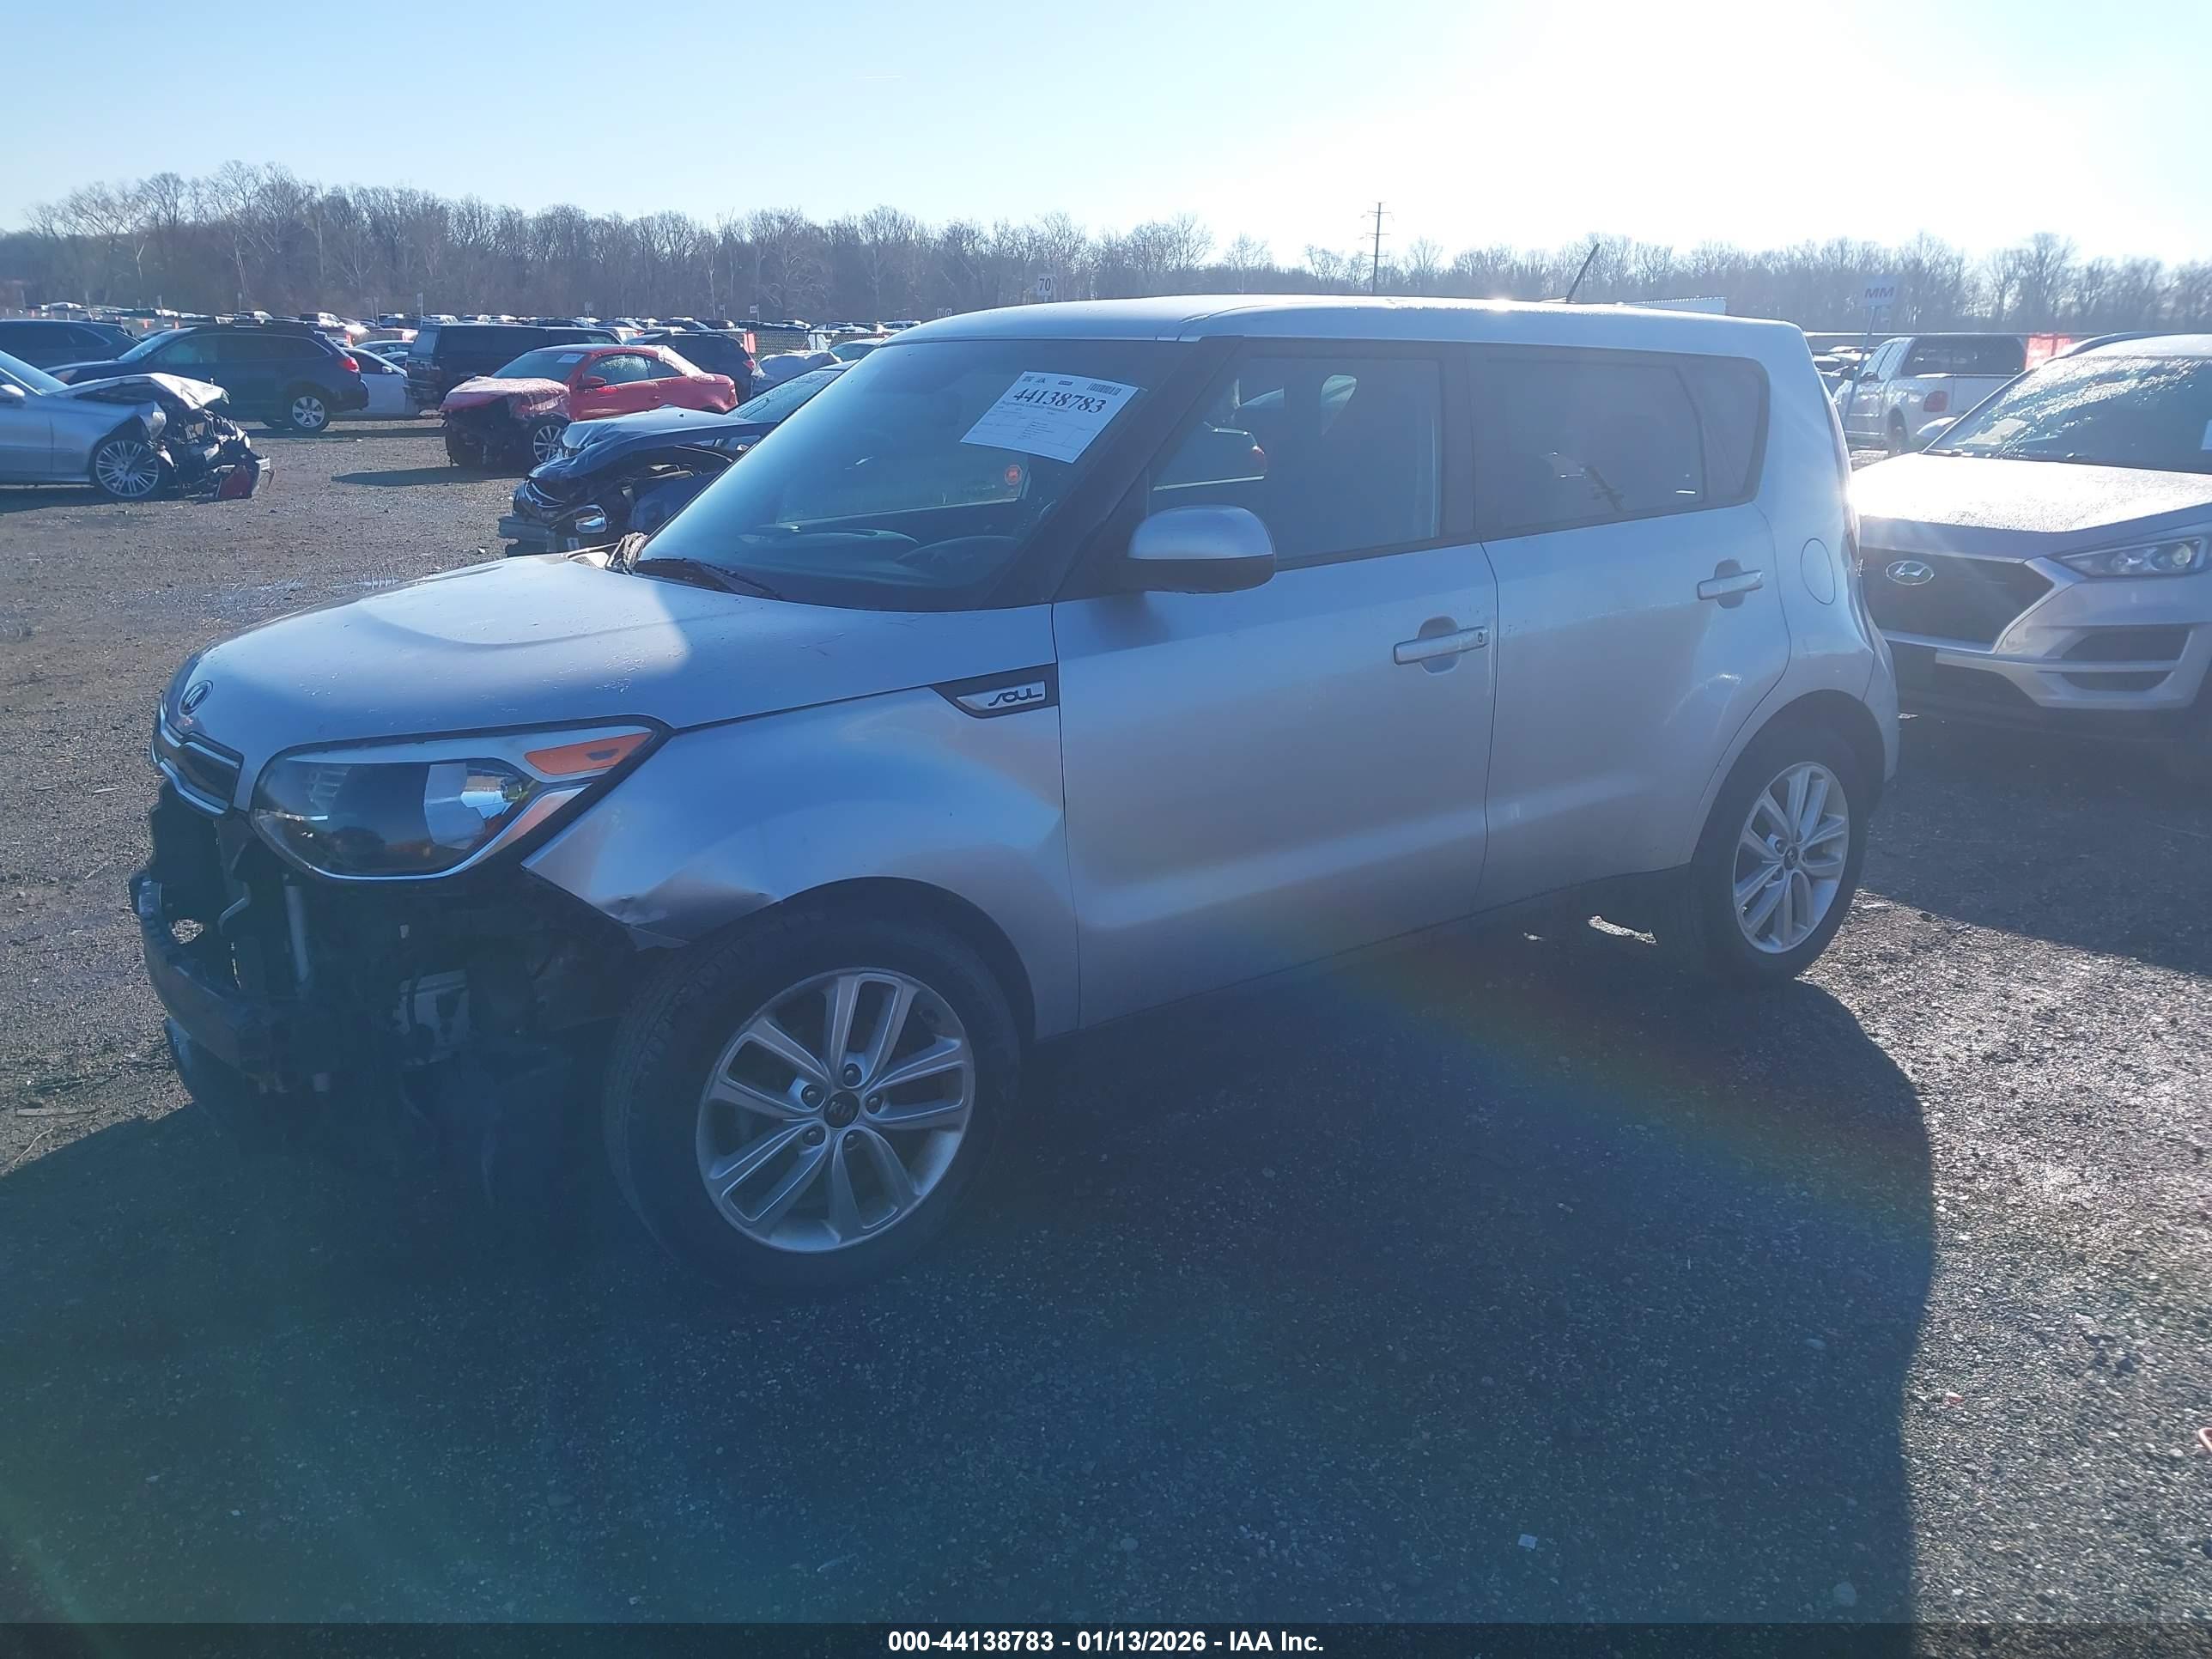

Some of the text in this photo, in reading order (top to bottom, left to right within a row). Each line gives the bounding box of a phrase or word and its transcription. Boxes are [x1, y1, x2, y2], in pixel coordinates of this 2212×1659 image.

[1038, 277, 1052, 292] 70
[1864, 287, 1895, 298] MM
[1013, 388, 1107, 414] 44138783
